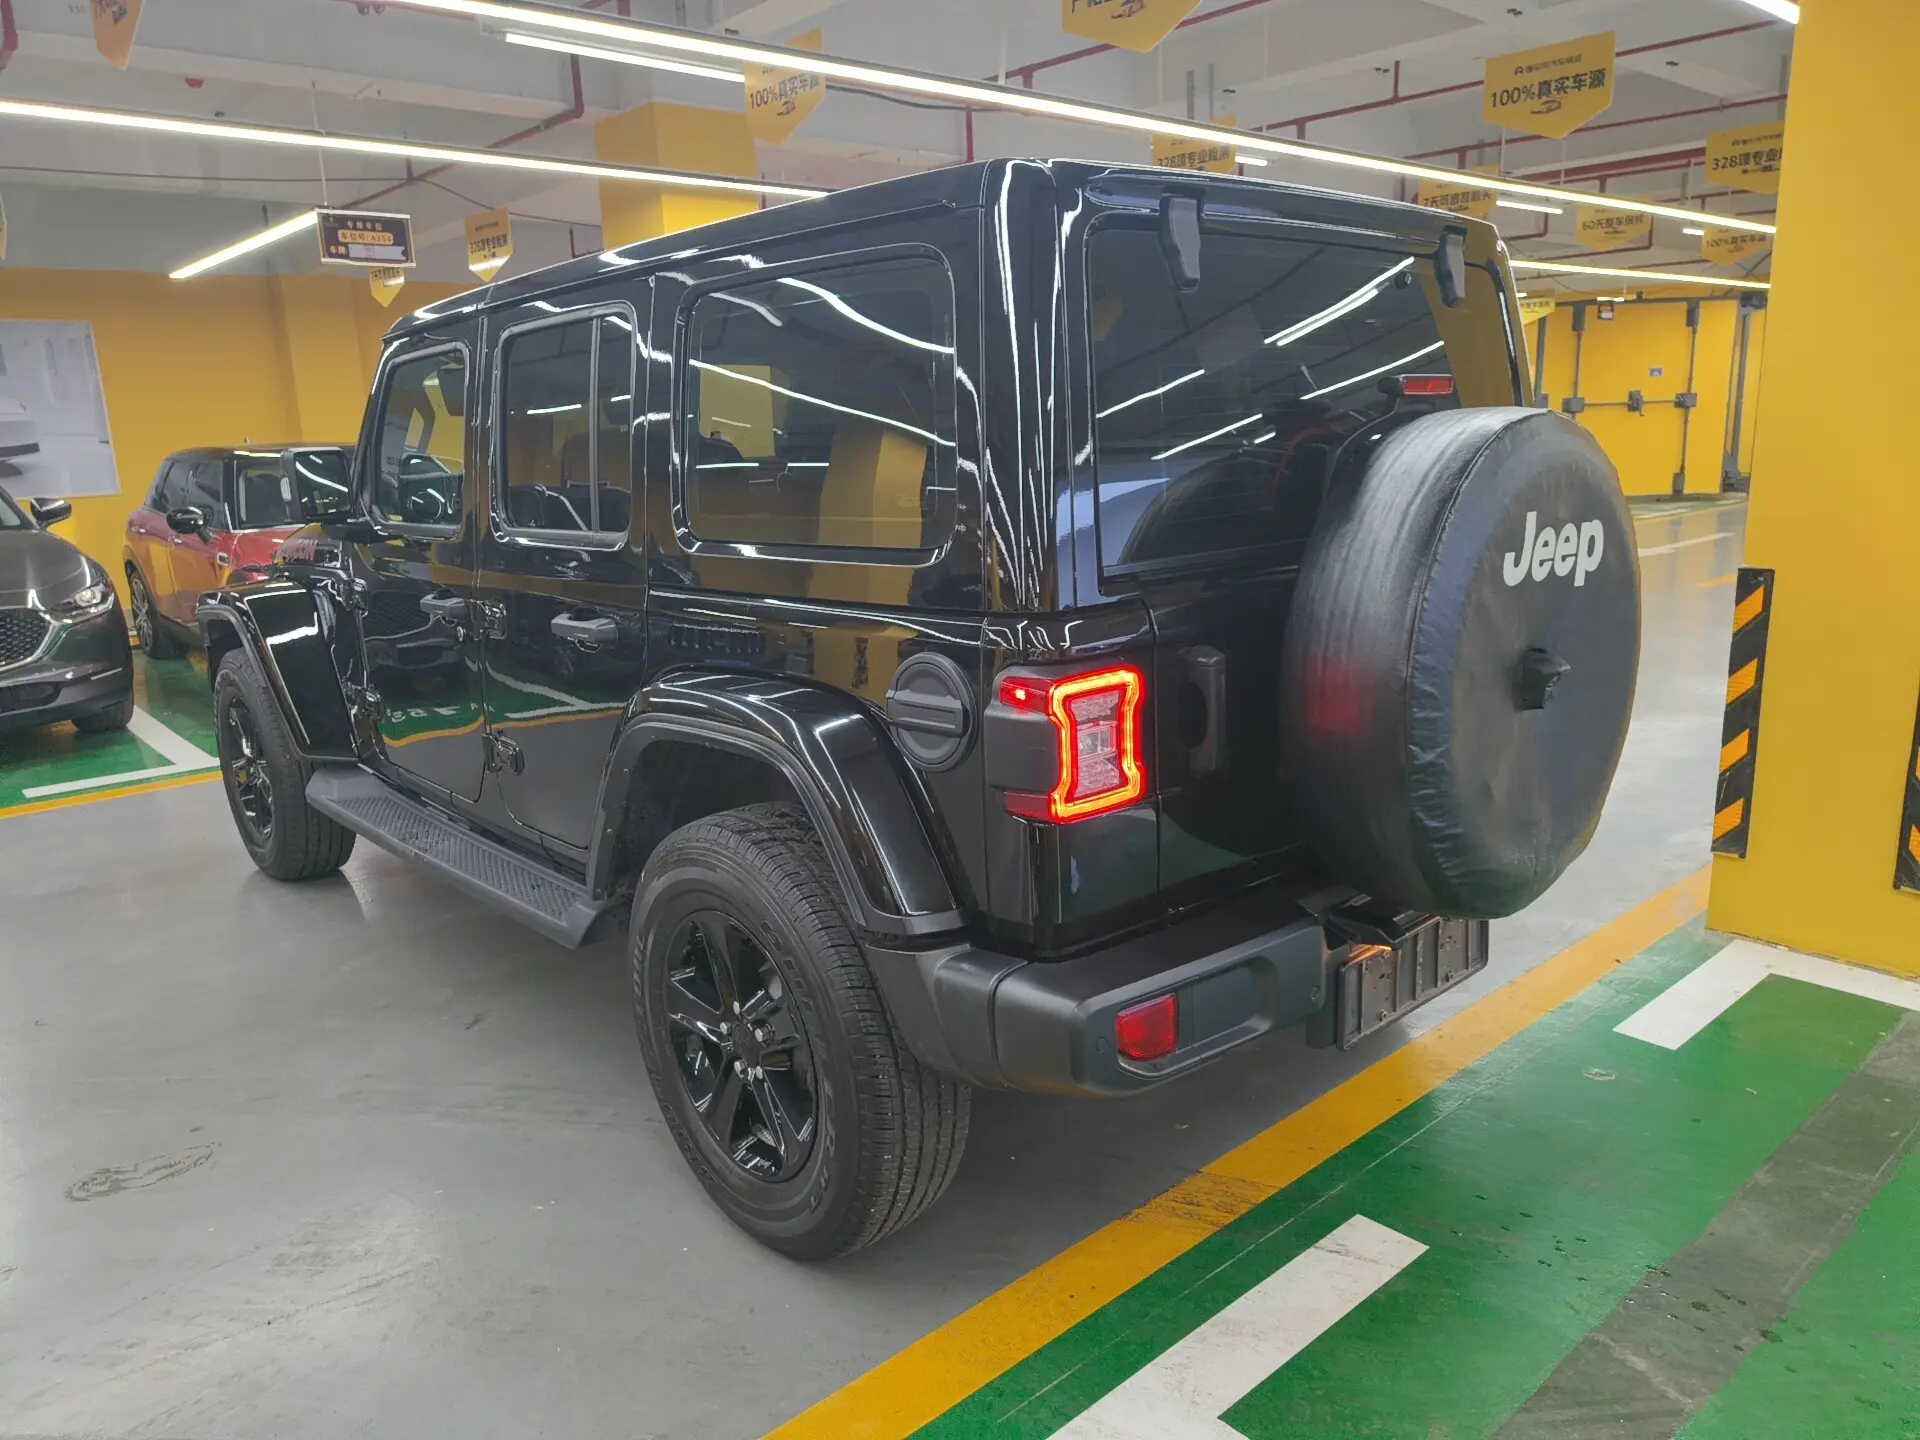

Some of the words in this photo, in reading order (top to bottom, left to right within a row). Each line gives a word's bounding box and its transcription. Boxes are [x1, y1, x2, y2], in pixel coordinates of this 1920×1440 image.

[1491, 67, 1606, 109] 100%真实车源
[1711, 148, 1782, 171] 328项专业
[1502, 511, 1604, 588] Jeep
